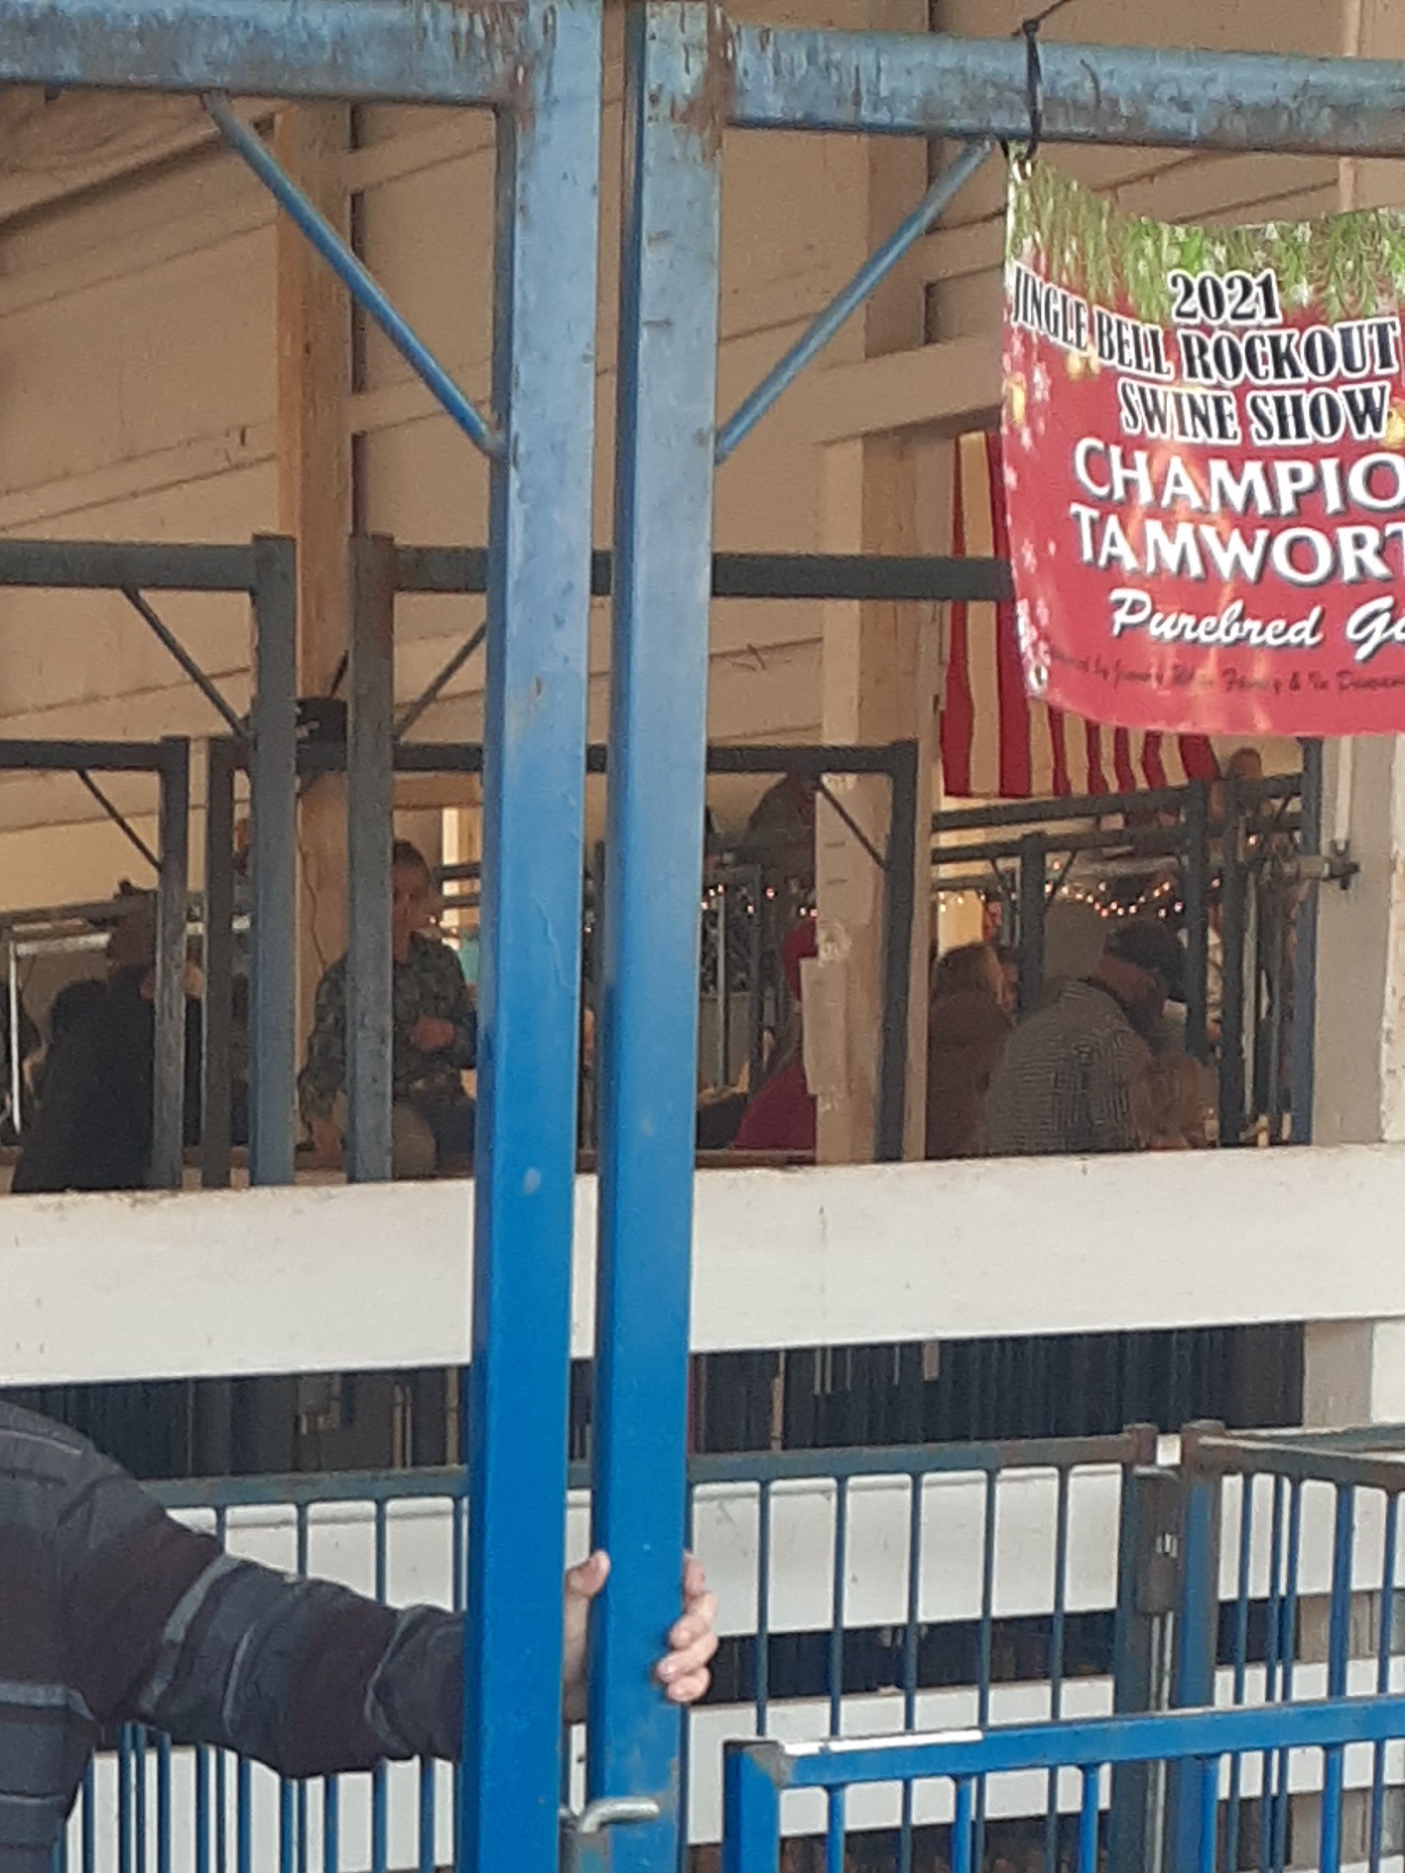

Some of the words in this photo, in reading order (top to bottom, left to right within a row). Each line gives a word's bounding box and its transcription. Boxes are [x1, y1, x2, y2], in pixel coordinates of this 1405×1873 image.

[1010, 264, 1090, 352] JINGLE
[1095, 306, 1172, 381] BELL
[1180, 319, 1398, 384] ROCKOUT
[1168, 270, 1281, 322] 2021
[1119, 377, 1241, 444] SWINE
[1247, 382, 1392, 446] SHOW
[1074, 438, 1405, 516] CHAMPIO
[1109, 588, 1326, 648] Purebred
